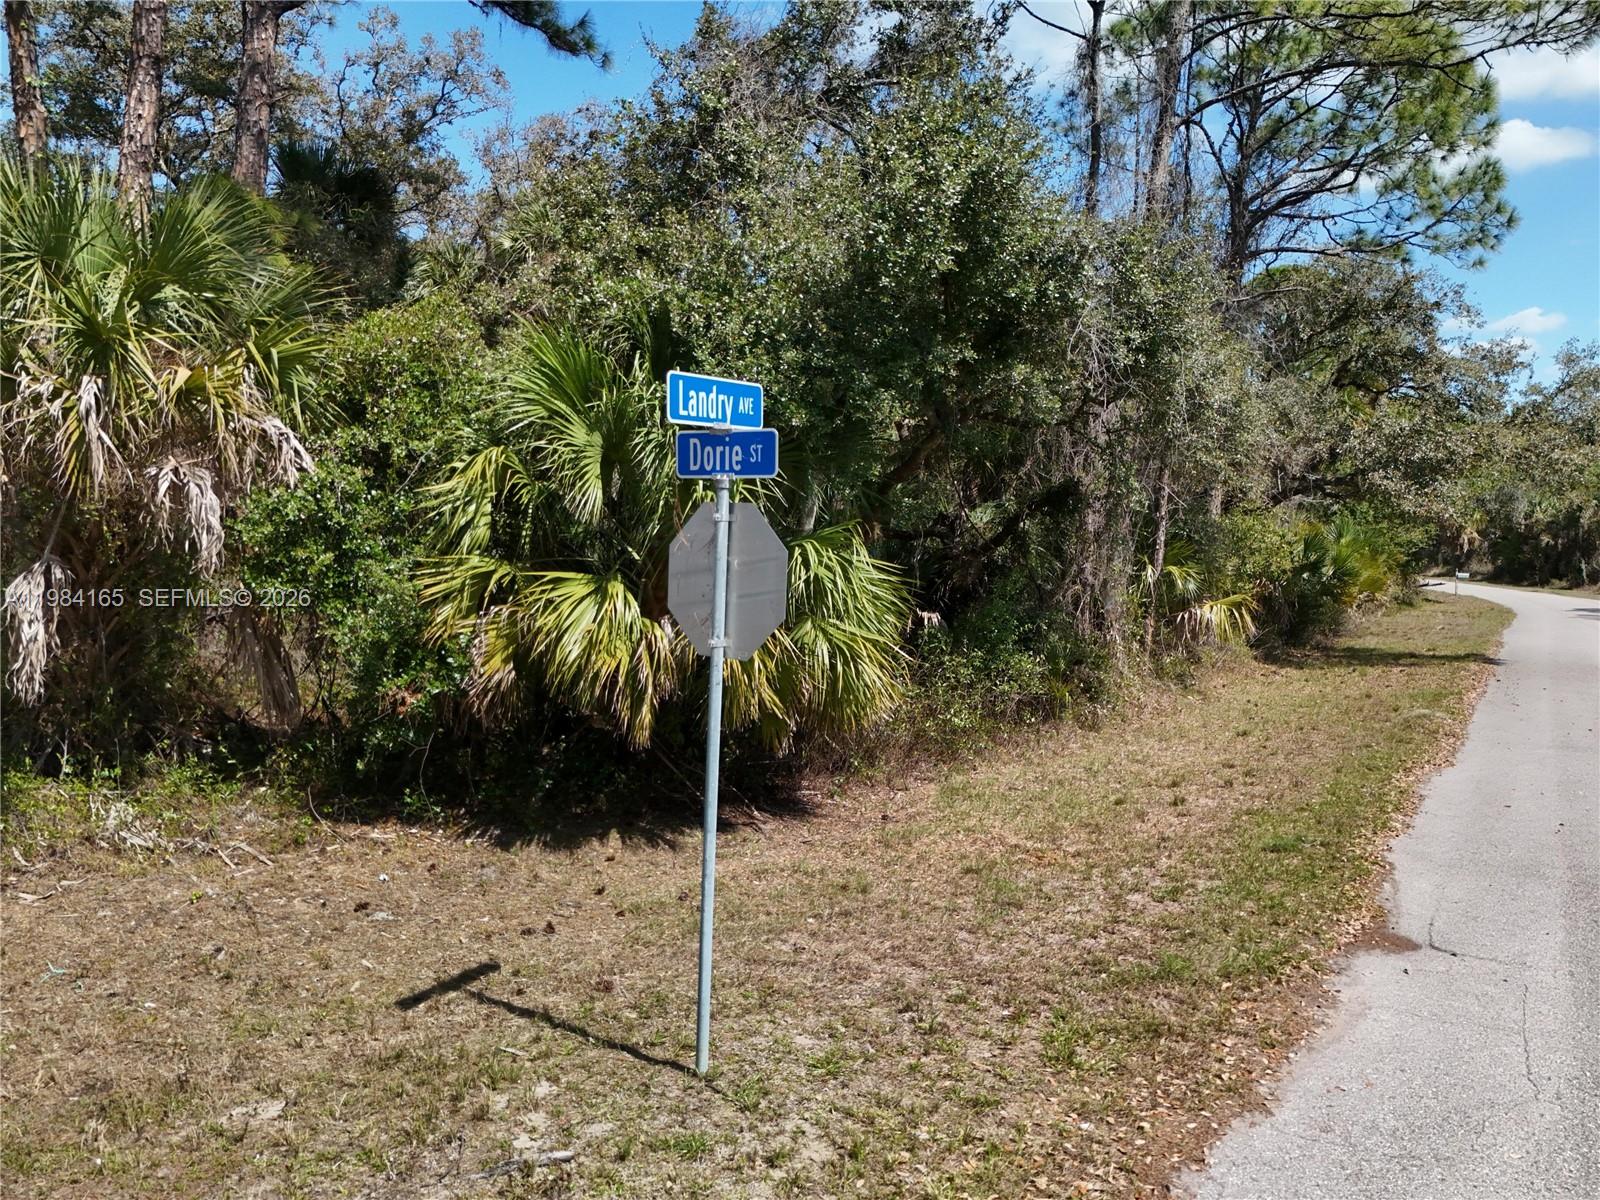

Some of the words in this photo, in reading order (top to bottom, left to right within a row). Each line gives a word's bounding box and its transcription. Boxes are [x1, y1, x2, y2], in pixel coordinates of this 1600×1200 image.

[679, 379, 734, 425] Landry
[738, 396, 754, 415] AVE
[689, 436, 742, 471] Dorie
[750, 444, 763, 463] ST
